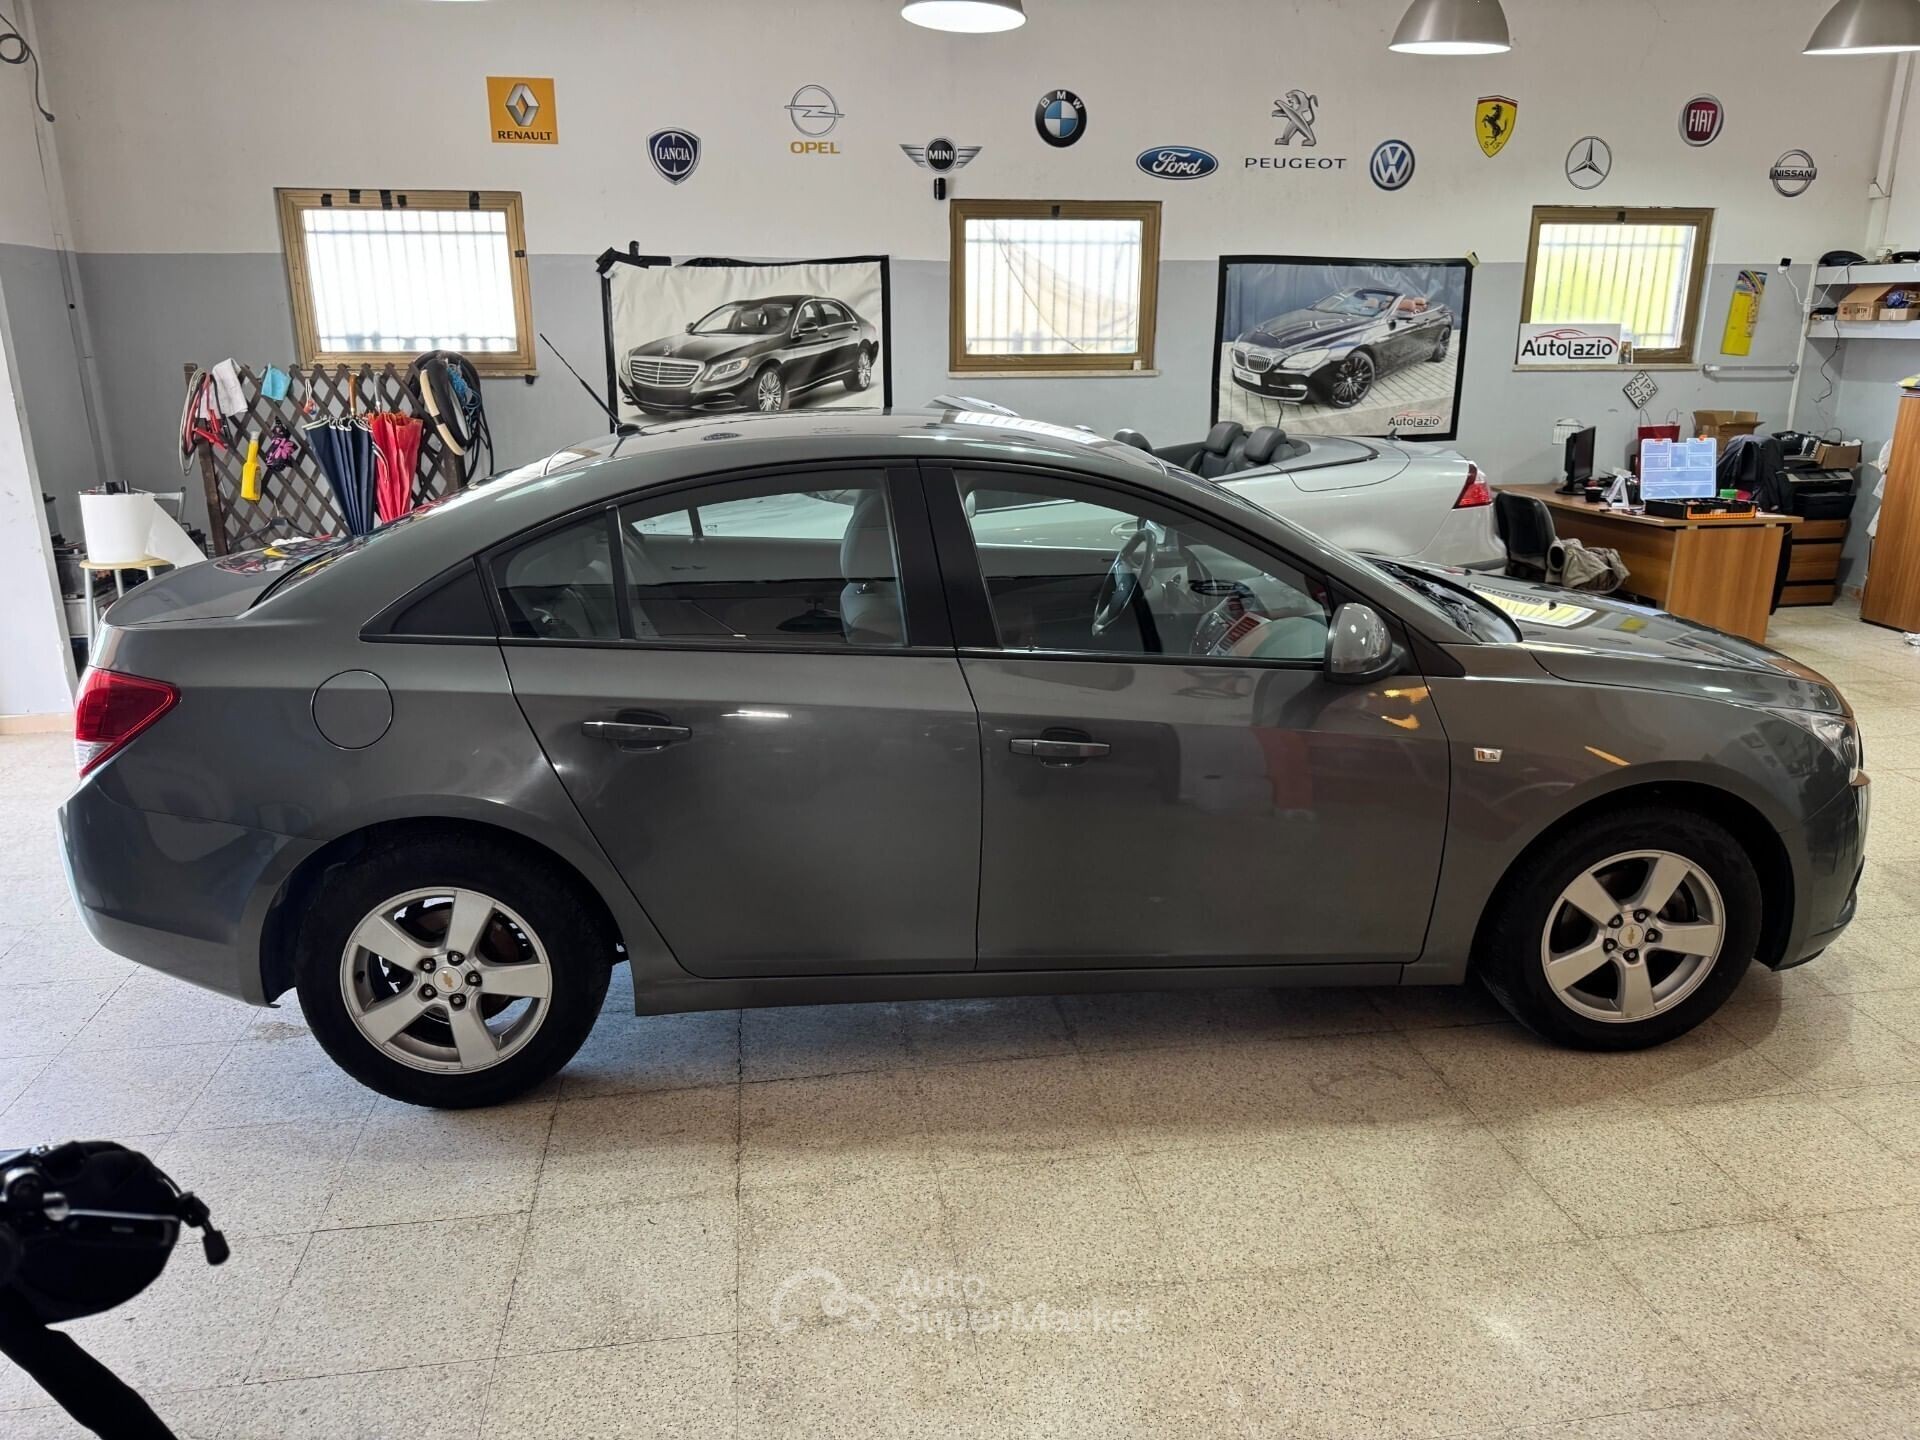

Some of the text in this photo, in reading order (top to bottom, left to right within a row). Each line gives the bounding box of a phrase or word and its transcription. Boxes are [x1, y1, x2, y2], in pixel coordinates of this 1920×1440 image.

[1040, 90, 1083, 109] BMW
[1689, 109, 1715, 133] FIAT
[497, 130, 552, 141] RENAULT
[659, 146, 690, 161] LANCIA
[790, 141, 841, 155] OPEL
[928, 150, 954, 160] MINI
[1151, 152, 1203, 174] Ford
[1245, 157, 1347, 169] PEUGEOT
[1774, 169, 1813, 178] NISSAN
[1521, 339, 1613, 359] AutoLazio
